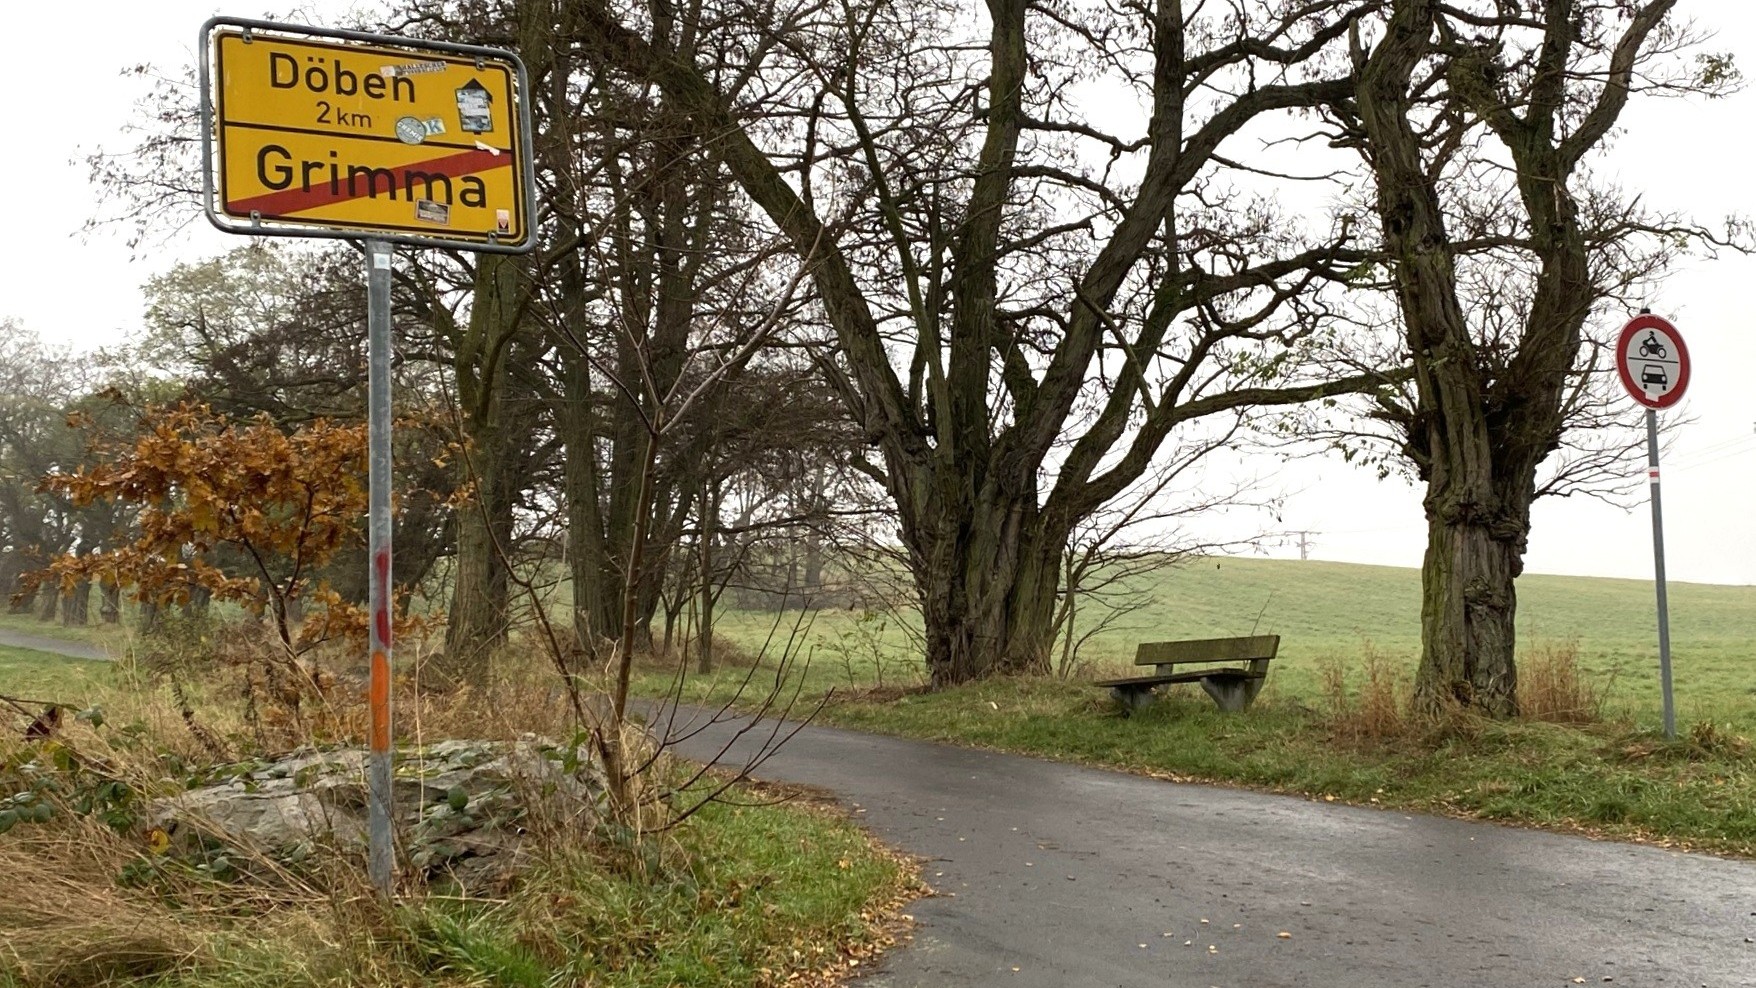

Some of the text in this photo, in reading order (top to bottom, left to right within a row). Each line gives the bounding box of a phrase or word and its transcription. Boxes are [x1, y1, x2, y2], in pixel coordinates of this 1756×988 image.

[269, 52, 416, 103] Döben
[316, 101, 372, 128] 2 km
[256, 145, 487, 208] Grimma
